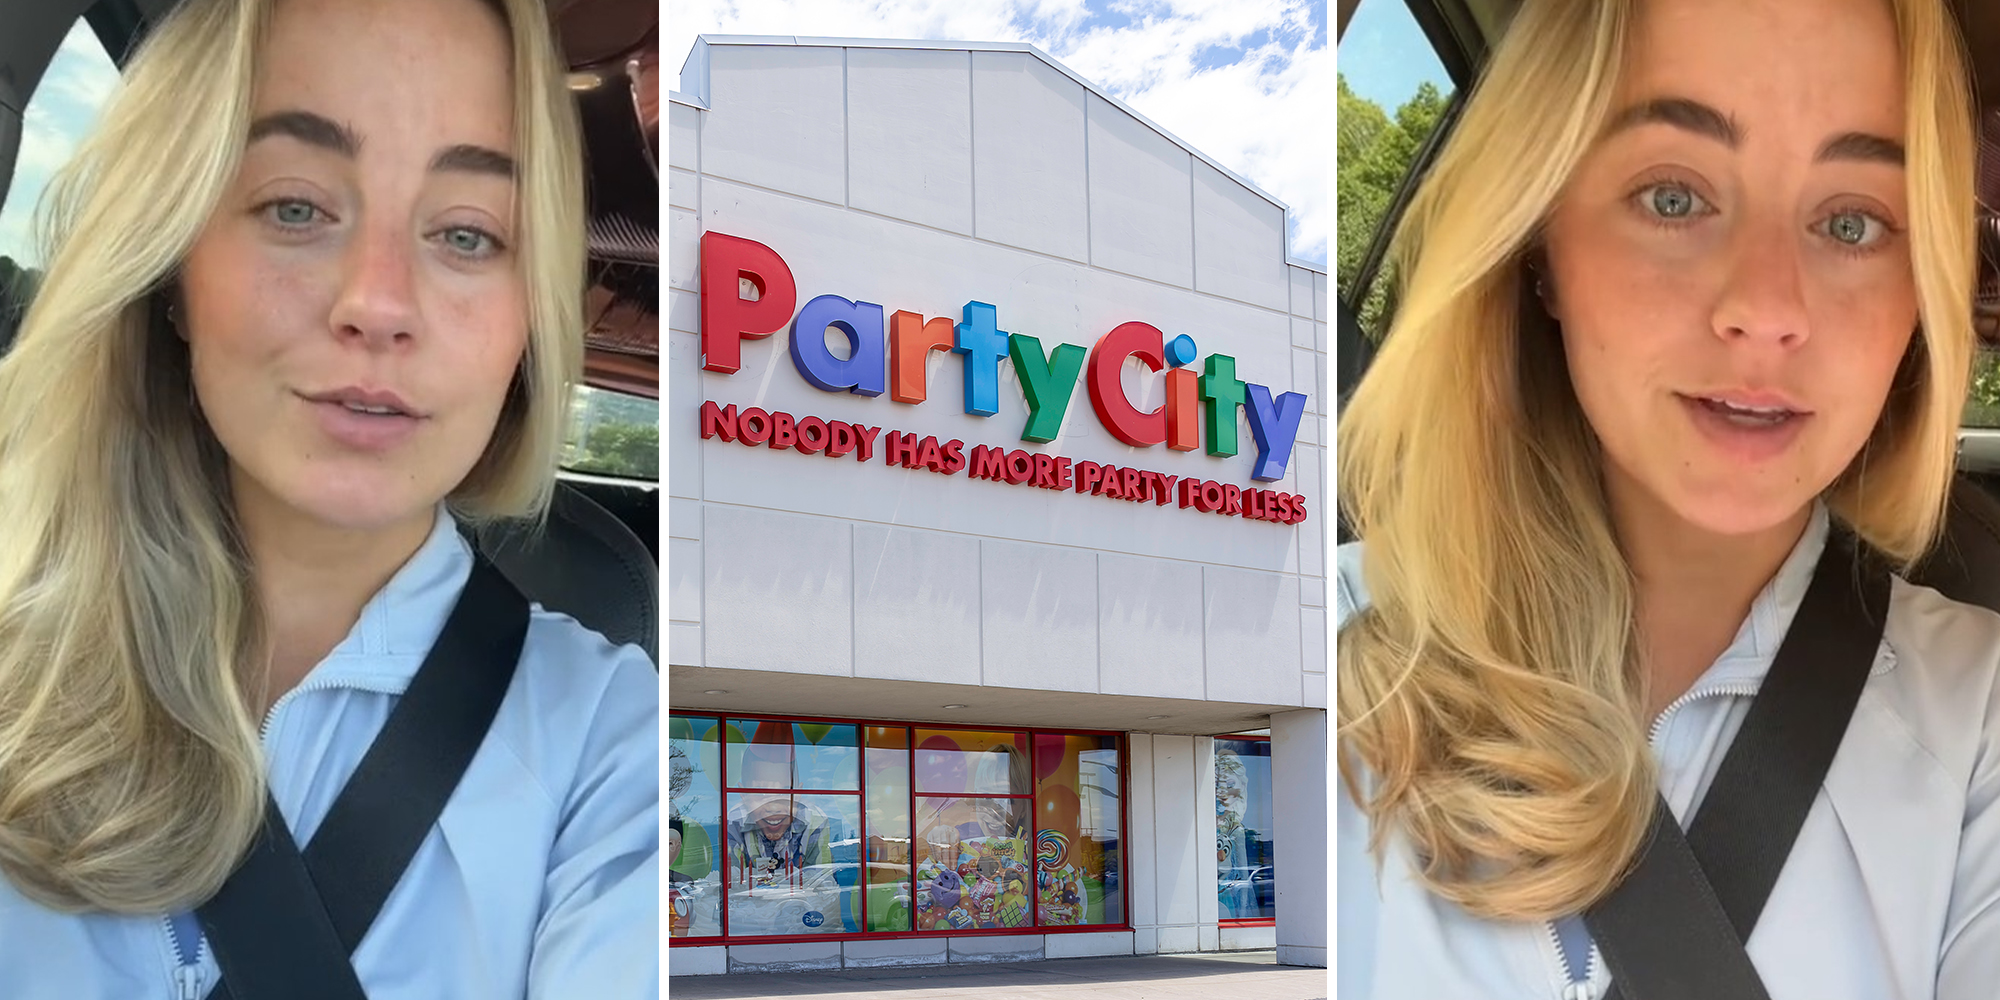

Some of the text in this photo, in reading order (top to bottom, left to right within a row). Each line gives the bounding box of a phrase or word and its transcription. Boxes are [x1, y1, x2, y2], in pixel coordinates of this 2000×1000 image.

[700, 400, 1307, 526] NOBODY HAS MORE PARTY FOR LESS
[804, 914, 824, 924] Disney
